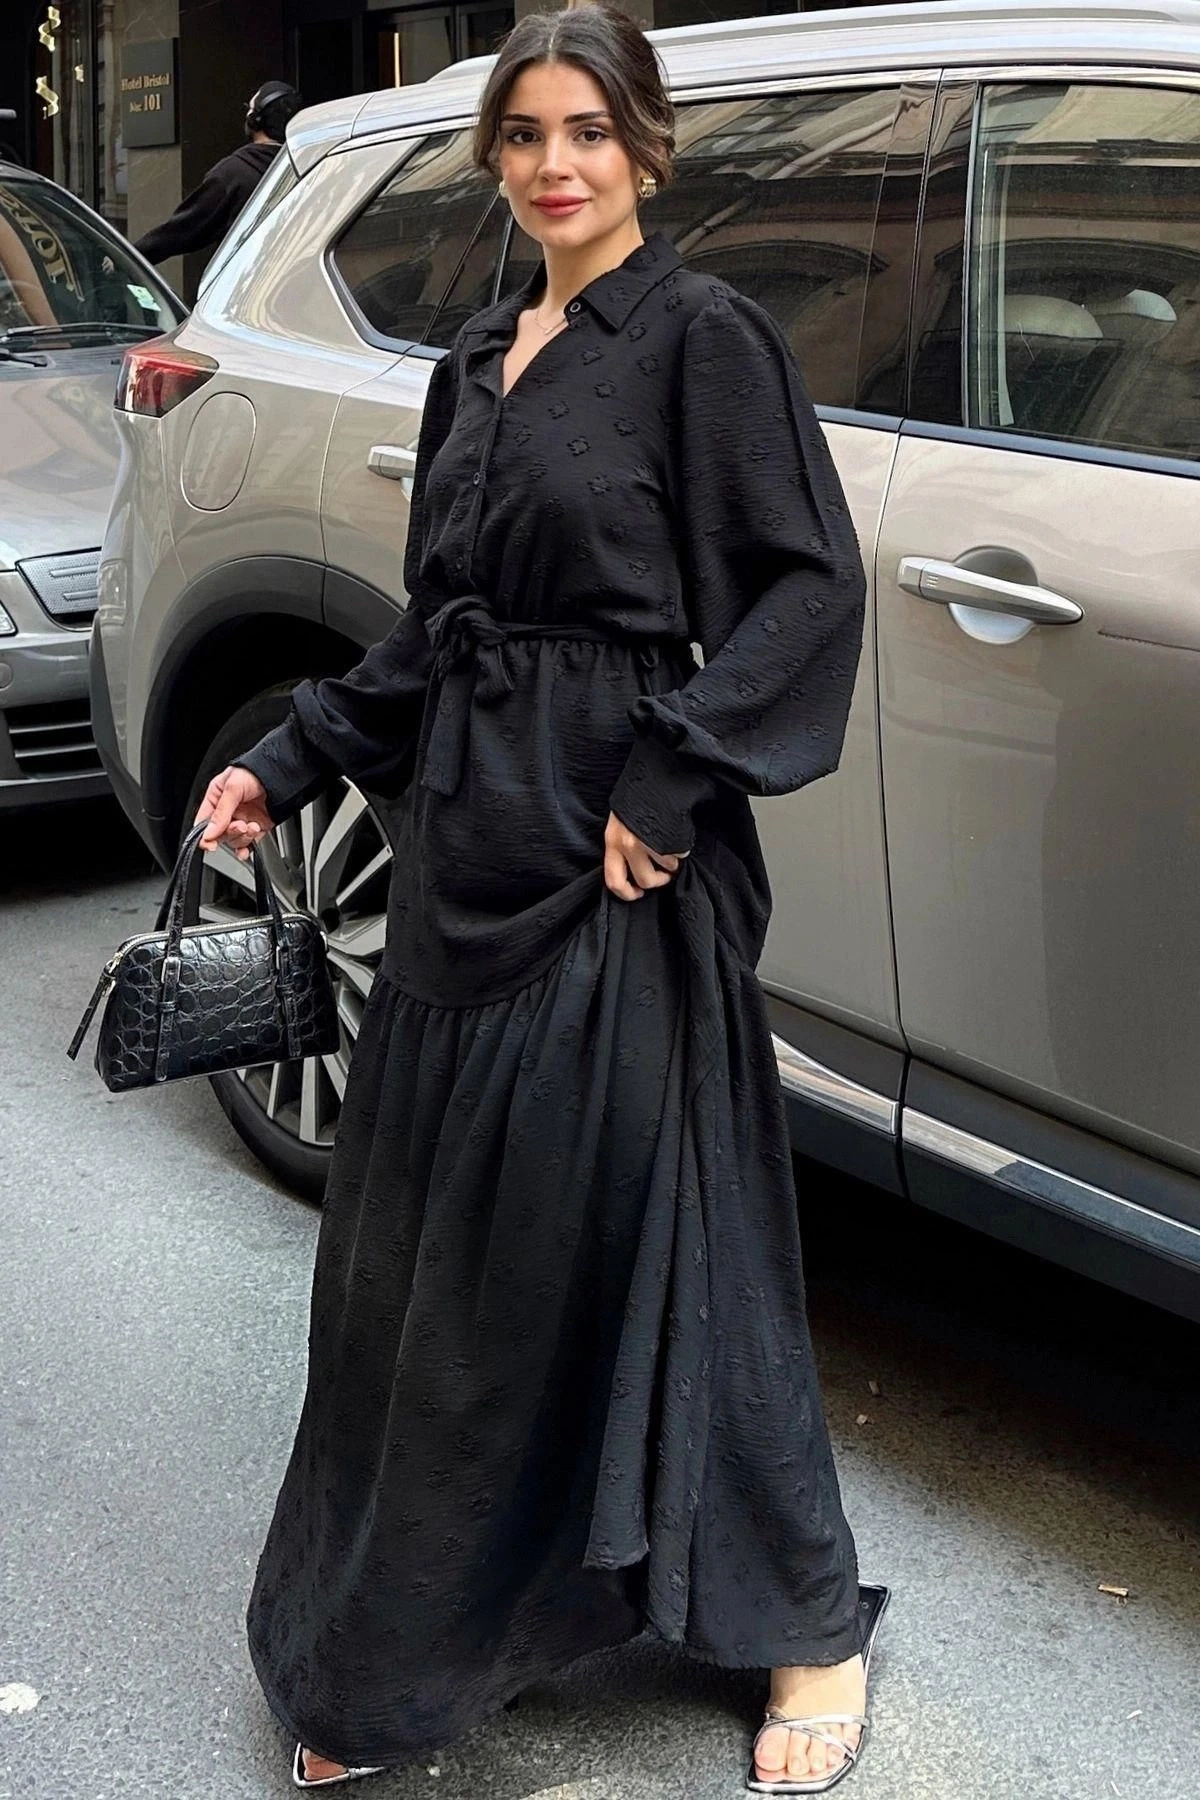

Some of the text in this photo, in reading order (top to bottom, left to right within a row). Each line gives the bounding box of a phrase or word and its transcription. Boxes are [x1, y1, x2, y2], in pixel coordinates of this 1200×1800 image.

[121, 72, 170, 91] Hotel Bristol
[144, 93, 161, 111] 101
